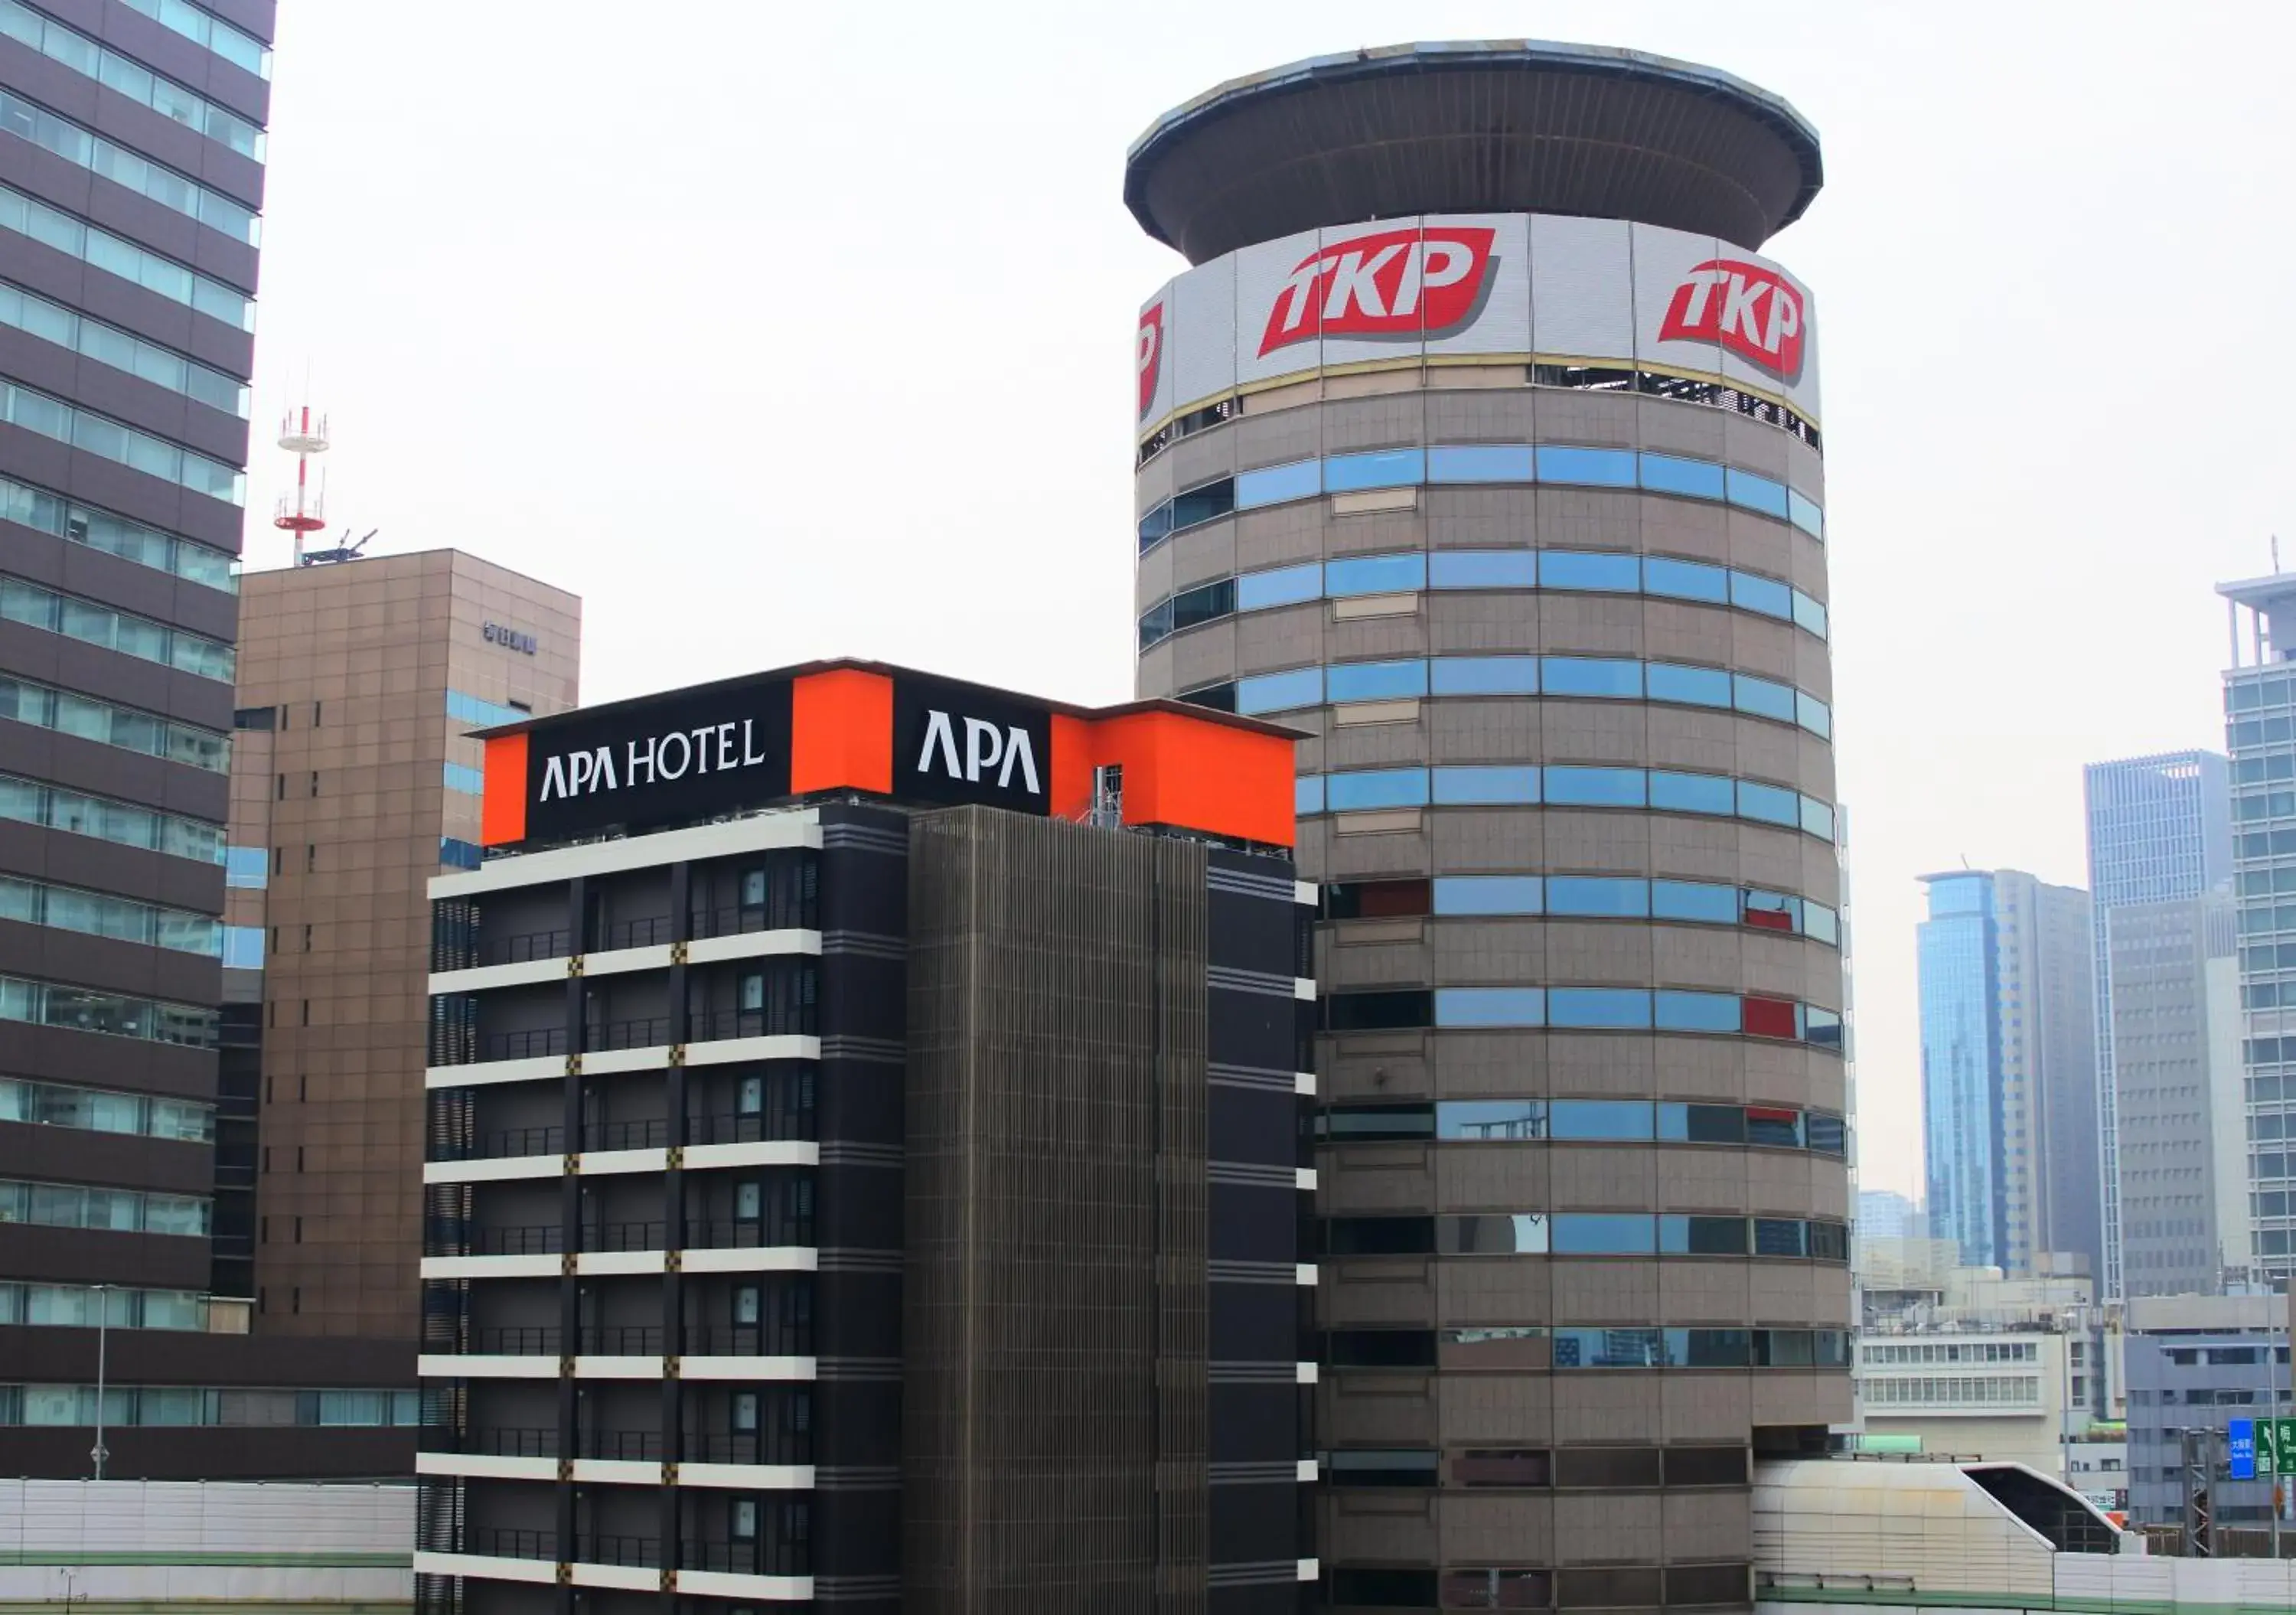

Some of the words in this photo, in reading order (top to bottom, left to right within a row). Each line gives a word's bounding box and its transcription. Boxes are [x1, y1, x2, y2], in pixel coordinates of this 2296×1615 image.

[1281, 241, 1473, 332] TKP
[1681, 269, 1798, 354] TKP
[540, 746, 618, 802] APA
[626, 719, 765, 786] HOTEL
[918, 710, 1040, 794] APA
